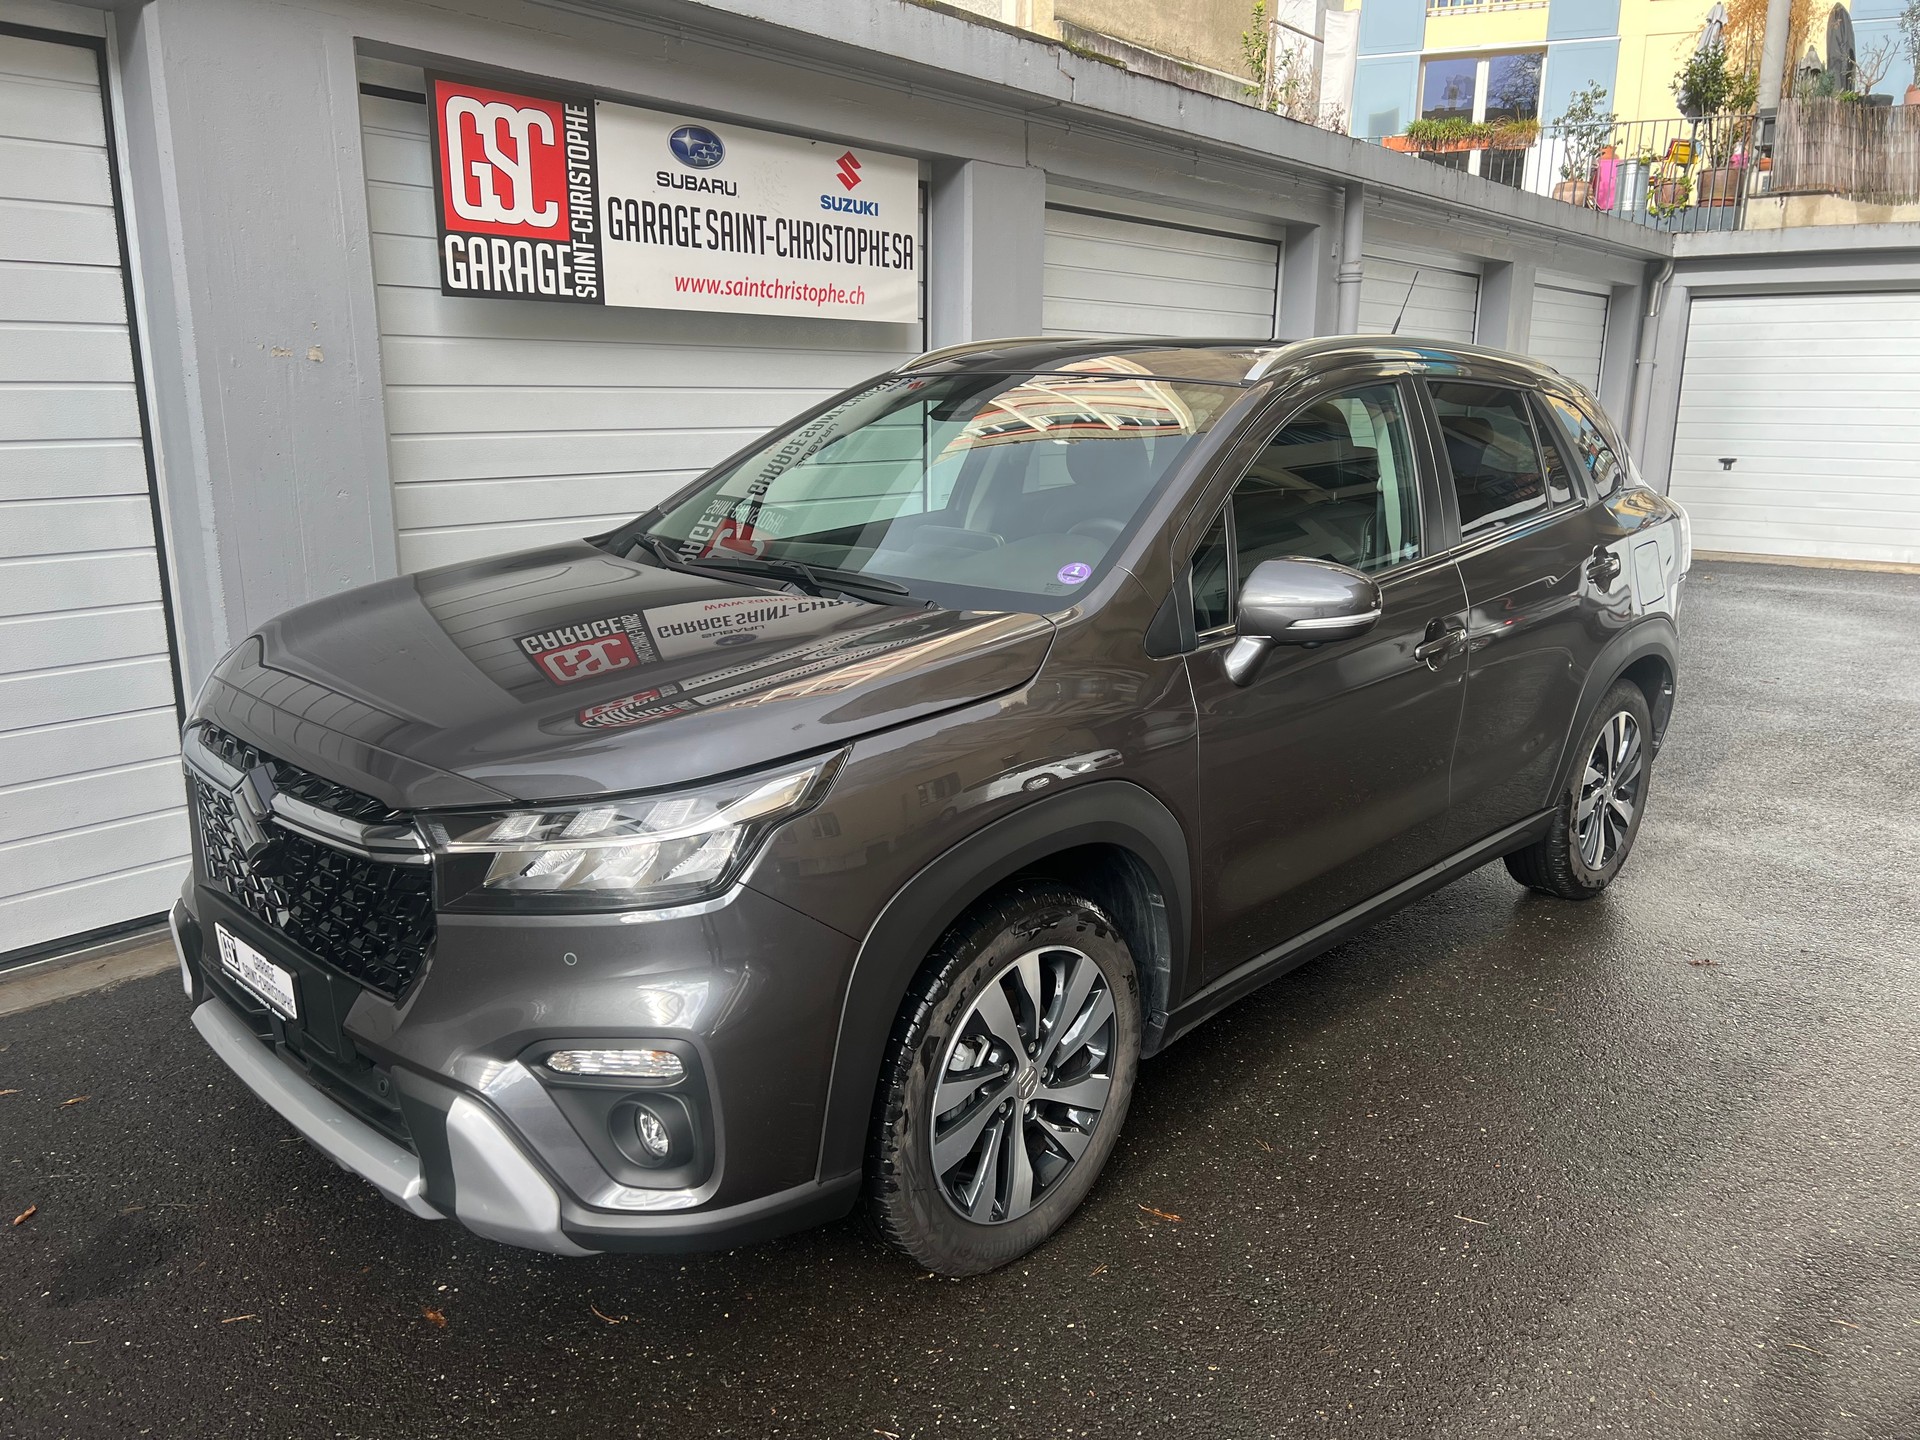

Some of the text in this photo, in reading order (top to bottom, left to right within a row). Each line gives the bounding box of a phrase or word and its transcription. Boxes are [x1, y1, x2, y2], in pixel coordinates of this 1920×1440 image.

[445, 95, 559, 228] GSC
[656, 171, 737, 196] SUBARU
[565, 103, 597, 298] SAINT-CHRISTOPHE
[820, 194, 879, 216] SUZUKI
[608, 196, 913, 270] GARAGE SAINT-CHRISTOPHE SA
[444, 234, 573, 296] GARAGE
[675, 276, 865, 307] www.saintchristophe.ch
[1070, 566, 1081, 575] 1
